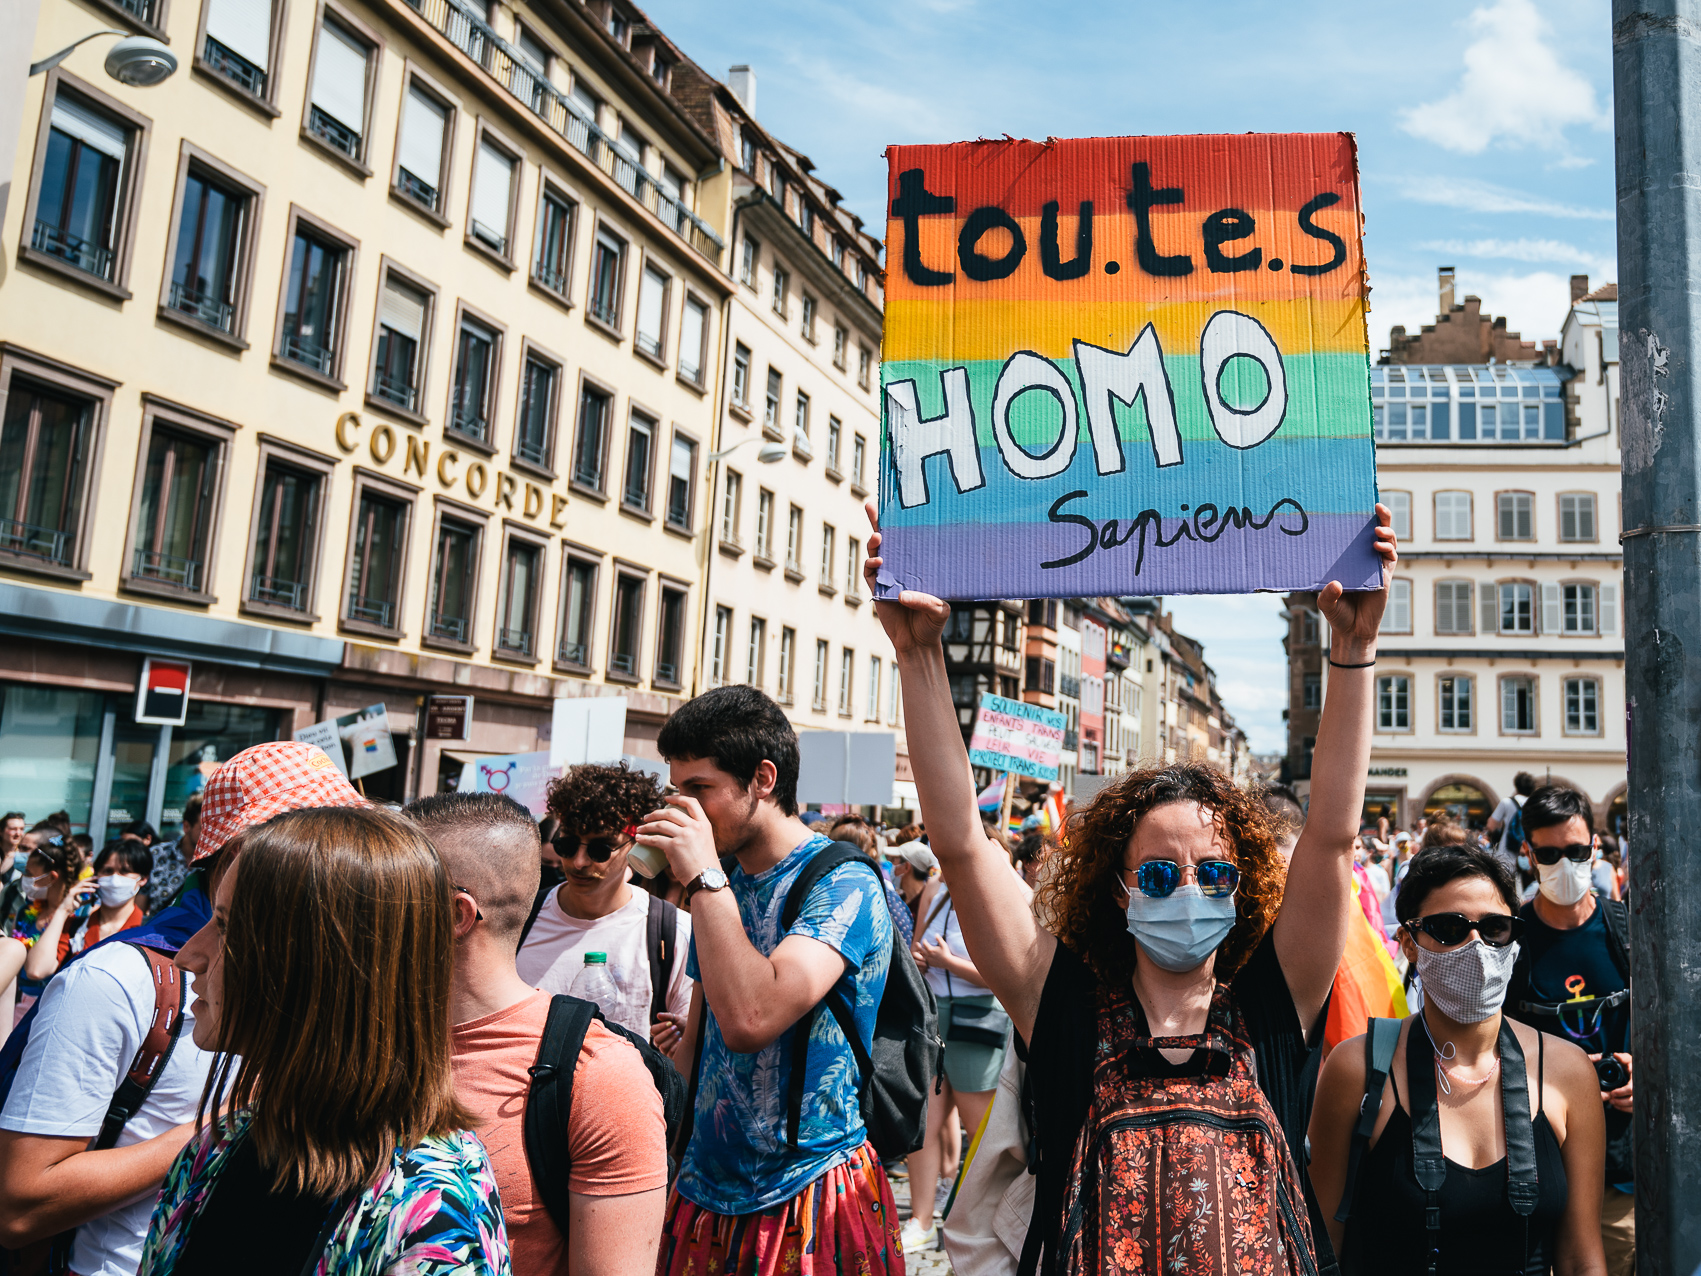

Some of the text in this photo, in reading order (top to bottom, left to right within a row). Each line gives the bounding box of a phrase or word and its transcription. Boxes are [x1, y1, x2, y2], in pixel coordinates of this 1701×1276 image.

[891, 162, 1347, 286] tou.te.s
[885, 310, 1288, 509] HOMO
[336, 411, 569, 529] CONCORDE
[1040, 490, 1309, 576] Sapiens
[991, 697, 1044, 722] SOUTENIR
[983, 711, 1061, 740] ENFANTS TRANS
[989, 724, 1014, 739] PEUT
[974, 749, 1007, 766] PROTECT
[1010, 756, 1037, 775] TRANS
[986, 738, 1046, 763] LEUR VIE
